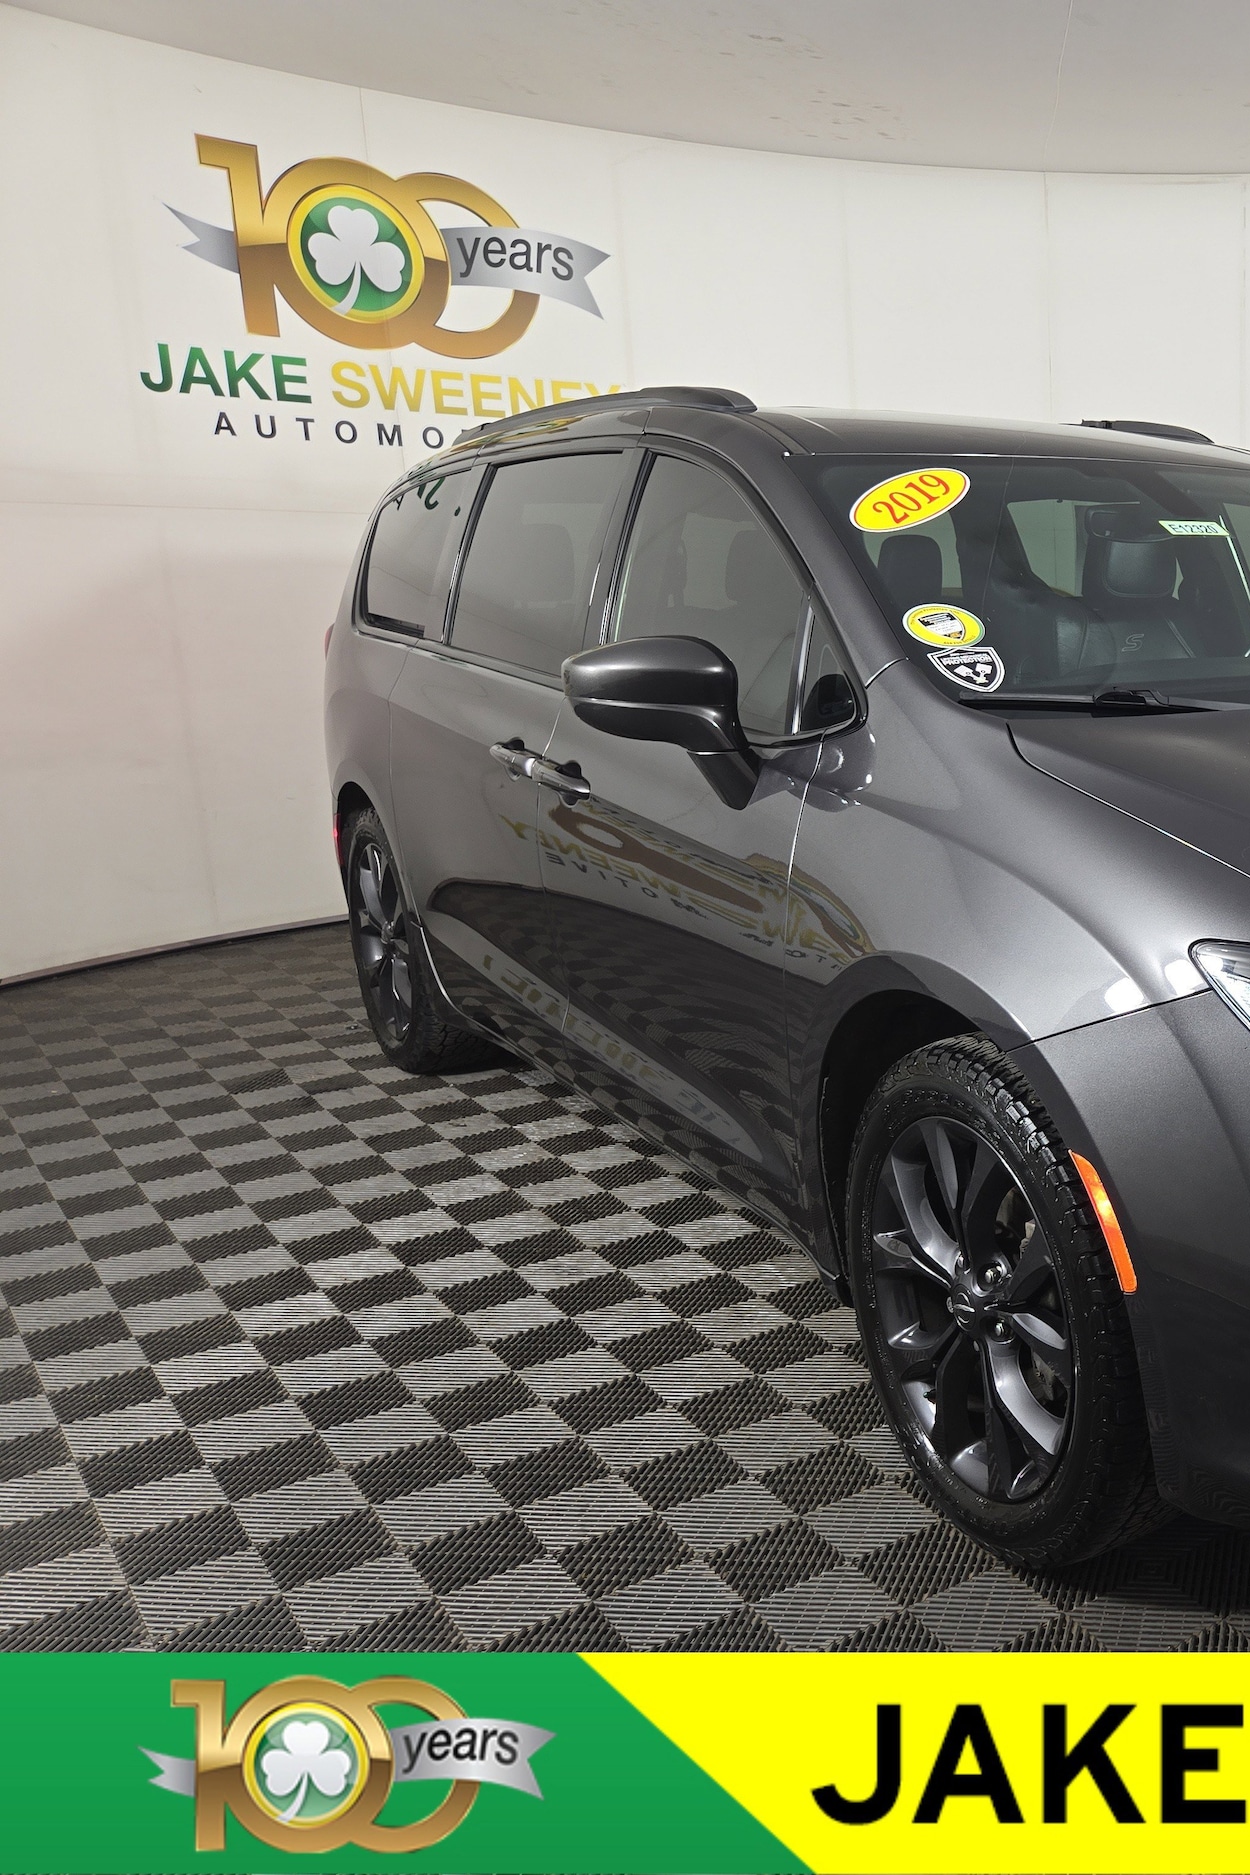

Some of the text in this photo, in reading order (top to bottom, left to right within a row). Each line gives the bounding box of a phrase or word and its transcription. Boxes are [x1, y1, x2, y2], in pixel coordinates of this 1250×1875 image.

[456, 236, 574, 281] years
[140, 343, 312, 404] JAKE
[872, 472, 951, 525] 2019
[1168, 524, 1219, 533] E12320
